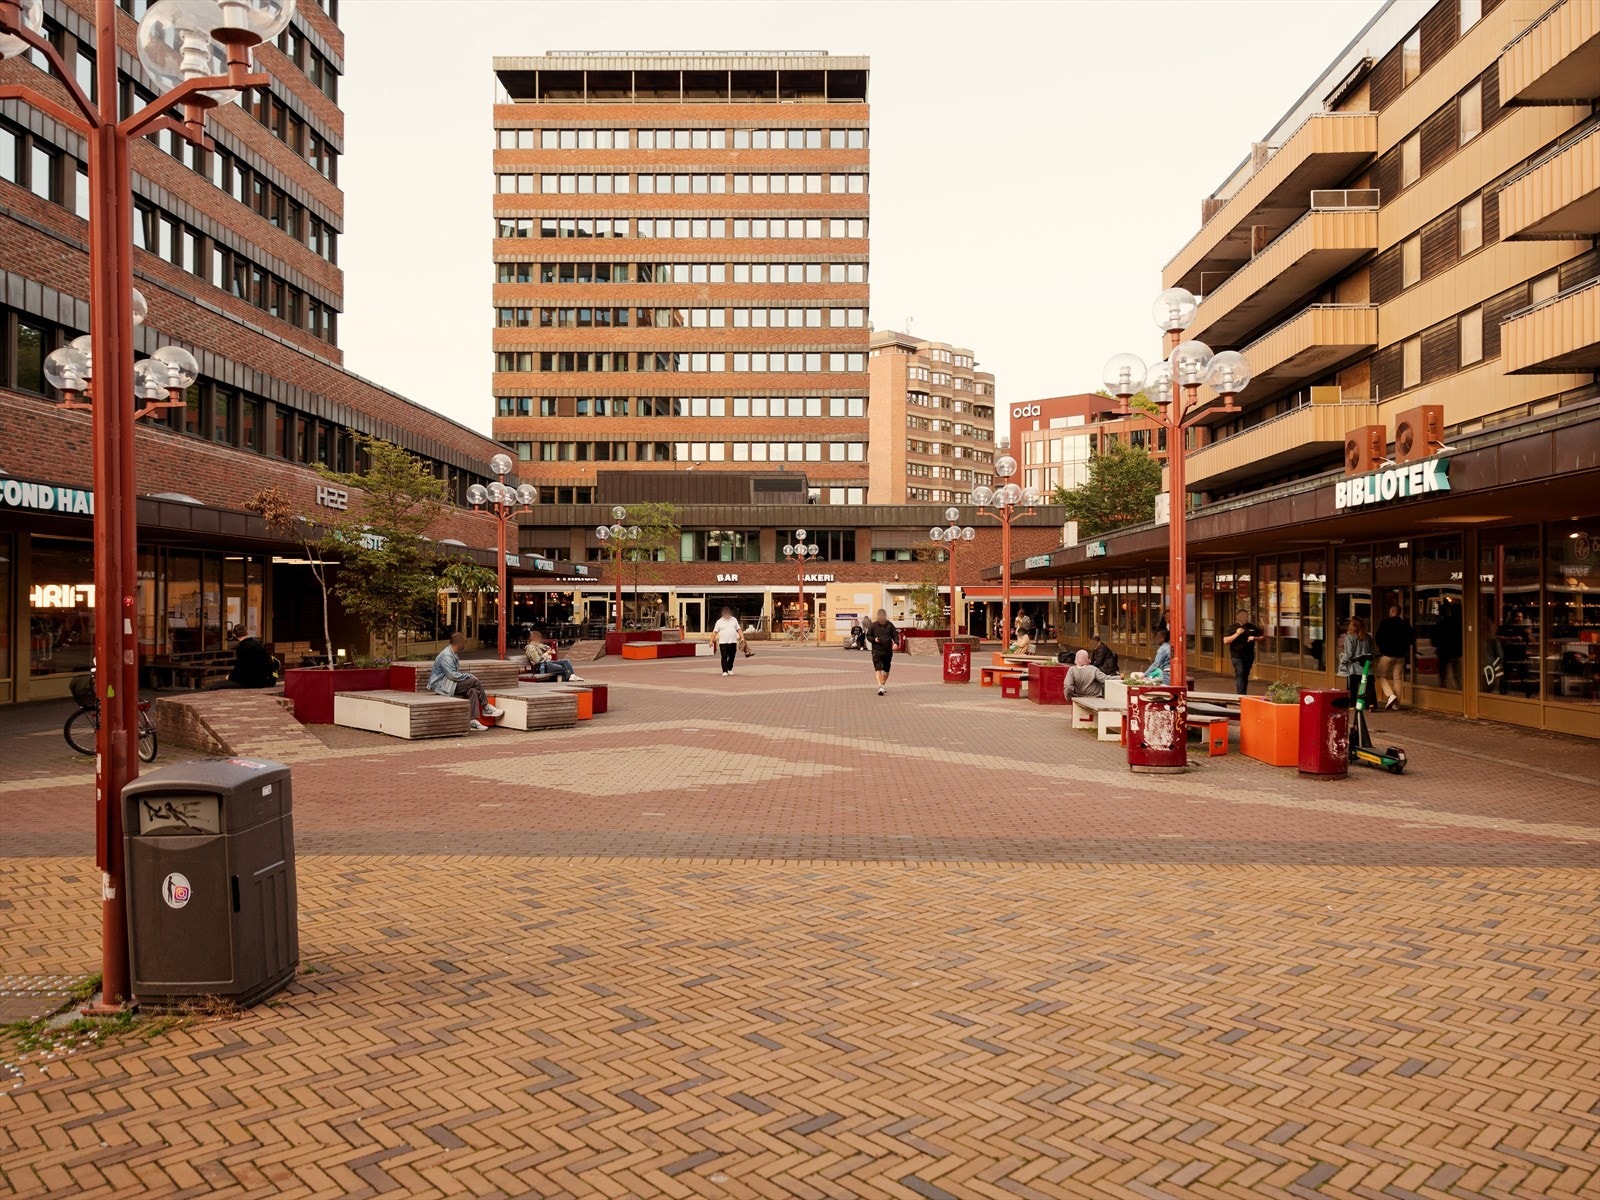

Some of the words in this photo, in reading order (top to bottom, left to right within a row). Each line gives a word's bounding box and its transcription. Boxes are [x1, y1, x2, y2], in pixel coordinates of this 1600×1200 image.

[1013, 404, 1041, 418] oda
[0, 480, 54, 510] OND
[1335, 459, 1441, 509] BIBLIOTEK
[716, 574, 739, 582] BAR
